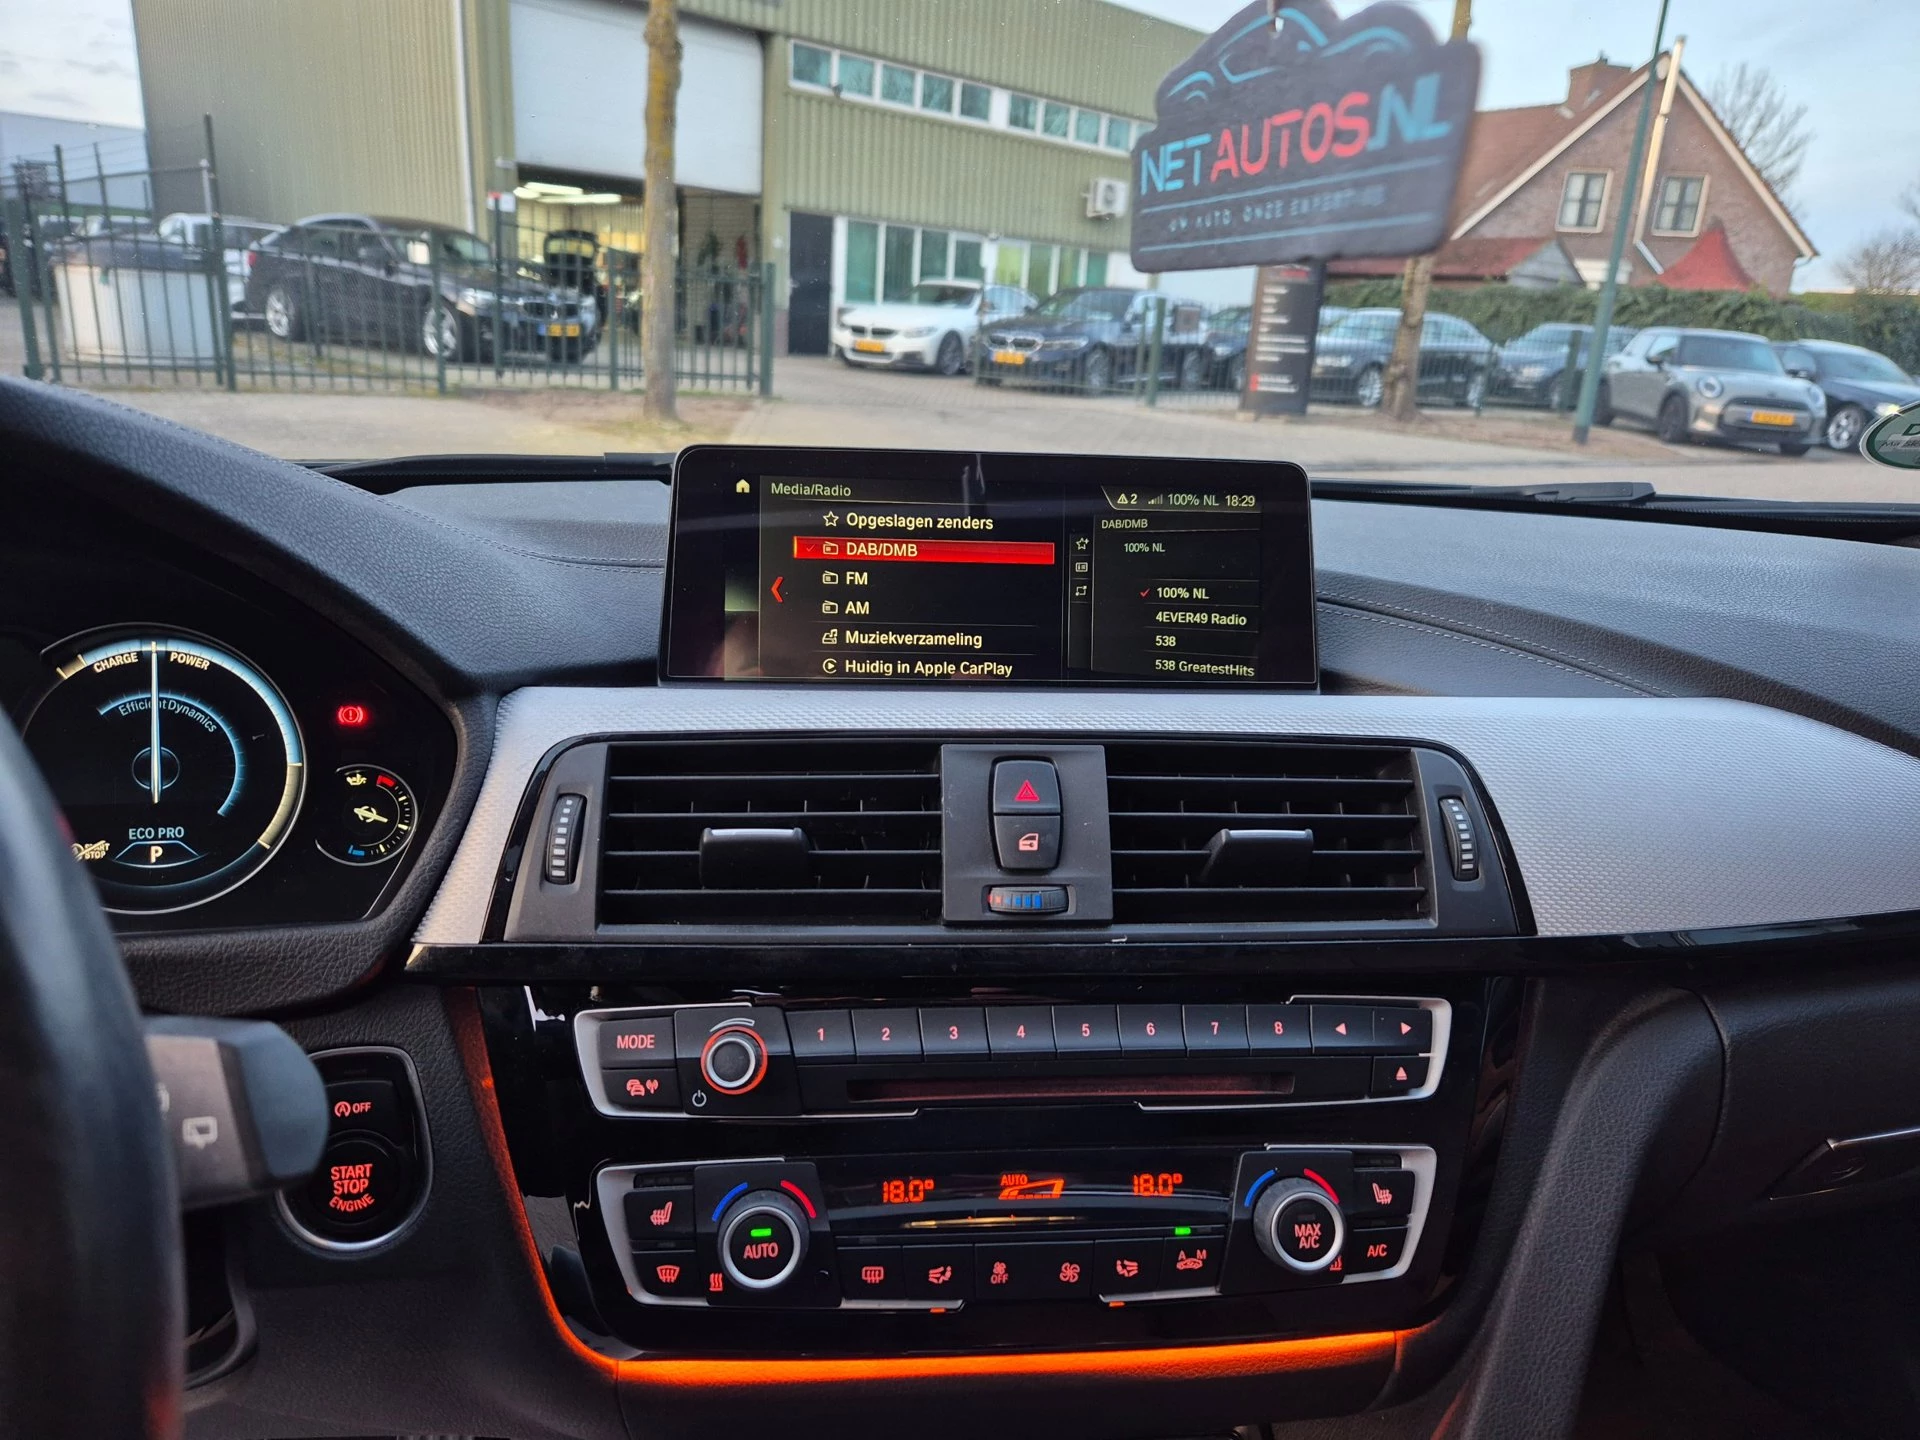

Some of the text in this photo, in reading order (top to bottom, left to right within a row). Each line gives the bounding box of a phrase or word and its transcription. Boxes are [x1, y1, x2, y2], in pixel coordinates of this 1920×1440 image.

[771, 482, 852, 497] Media/Radio
[1167, 494, 1200, 506] 100%
[1203, 494, 1220, 507] NL
[1225, 494, 1256, 508] 18:29
[846, 512, 994, 530] Opgeslagen zenders
[1101, 518, 1148, 529] DAB/DMB
[846, 542, 918, 557] DAB/DMB
[1124, 542, 1166, 553] 100% NL
[846, 572, 869, 586] FM
[1156, 587, 1210, 600] 100% NL
[845, 600, 870, 615] AM
[1155, 611, 1248, 626] 4EVER49 Radio
[845, 630, 983, 649] Muziekverzameling
[1155, 635, 1177, 647] 538
[93, 652, 139, 673] CHARGE
[169, 652, 210, 671] POWER
[845, 659, 1014, 678] Huidig in Apple CarPlay
[1155, 659, 1256, 677] 538 GreatestHits
[128, 826, 185, 840] ECO PRO
[150, 845, 163, 864] P
[817, 1027, 825, 1041] 1
[881, 1027, 891, 1041] 2
[949, 1026, 959, 1040] 3
[1016, 1024, 1026, 1039] 4
[1081, 1023, 1091, 1037] 5
[1146, 1022, 1156, 1036] 6
[1211, 1021, 1219, 1035] 7
[1274, 1021, 1284, 1035] 8
[616, 1034, 656, 1050] MODE
[352, 1102, 372, 1114] OFF
[330, 1164, 373, 1181] START
[333, 1179, 369, 1195] STOP
[1001, 1174, 1028, 1187] AUTO
[329, 1193, 375, 1212] ENGINE
[1294, 1222, 1322, 1238] MAX
[1299, 1235, 1320, 1249] A/C
[743, 1241, 779, 1259] AUTO
[1366, 1243, 1388, 1258] A/C
[990, 1273, 1009, 1285] OFF
